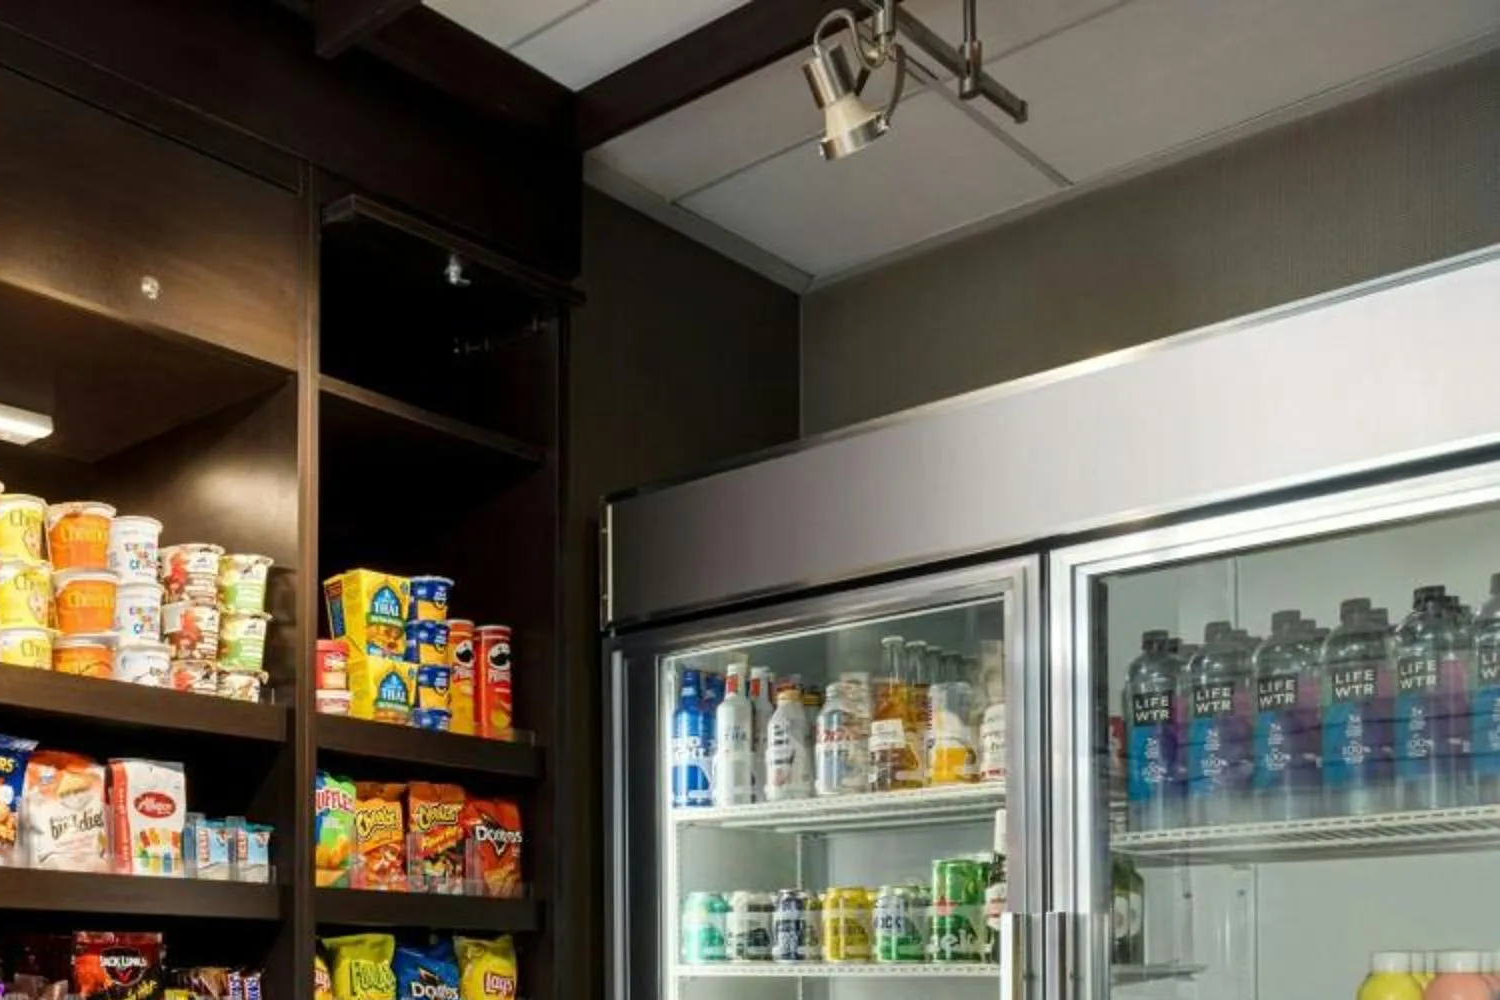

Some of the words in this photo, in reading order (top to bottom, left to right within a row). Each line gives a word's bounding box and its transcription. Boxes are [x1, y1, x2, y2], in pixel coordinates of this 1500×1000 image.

[1480, 652, 1498, 666] LI
[1401, 659, 1437, 676] LIFE
[1335, 669, 1376, 685] LIFE
[1400, 675, 1437, 689] WTR
[1196, 687, 1233, 701] LIFE
[1258, 679, 1296, 694] LIFE
[1335, 684, 1375, 699] WTR
[1134, 695, 1170, 710] LIFE
[1195, 700, 1233, 714] WTR
[1258, 693, 1296, 707] WTR
[1135, 709, 1170, 723] WTR
[474, 825, 523, 844] Doritos
[411, 981, 459, 1000] Doritos
